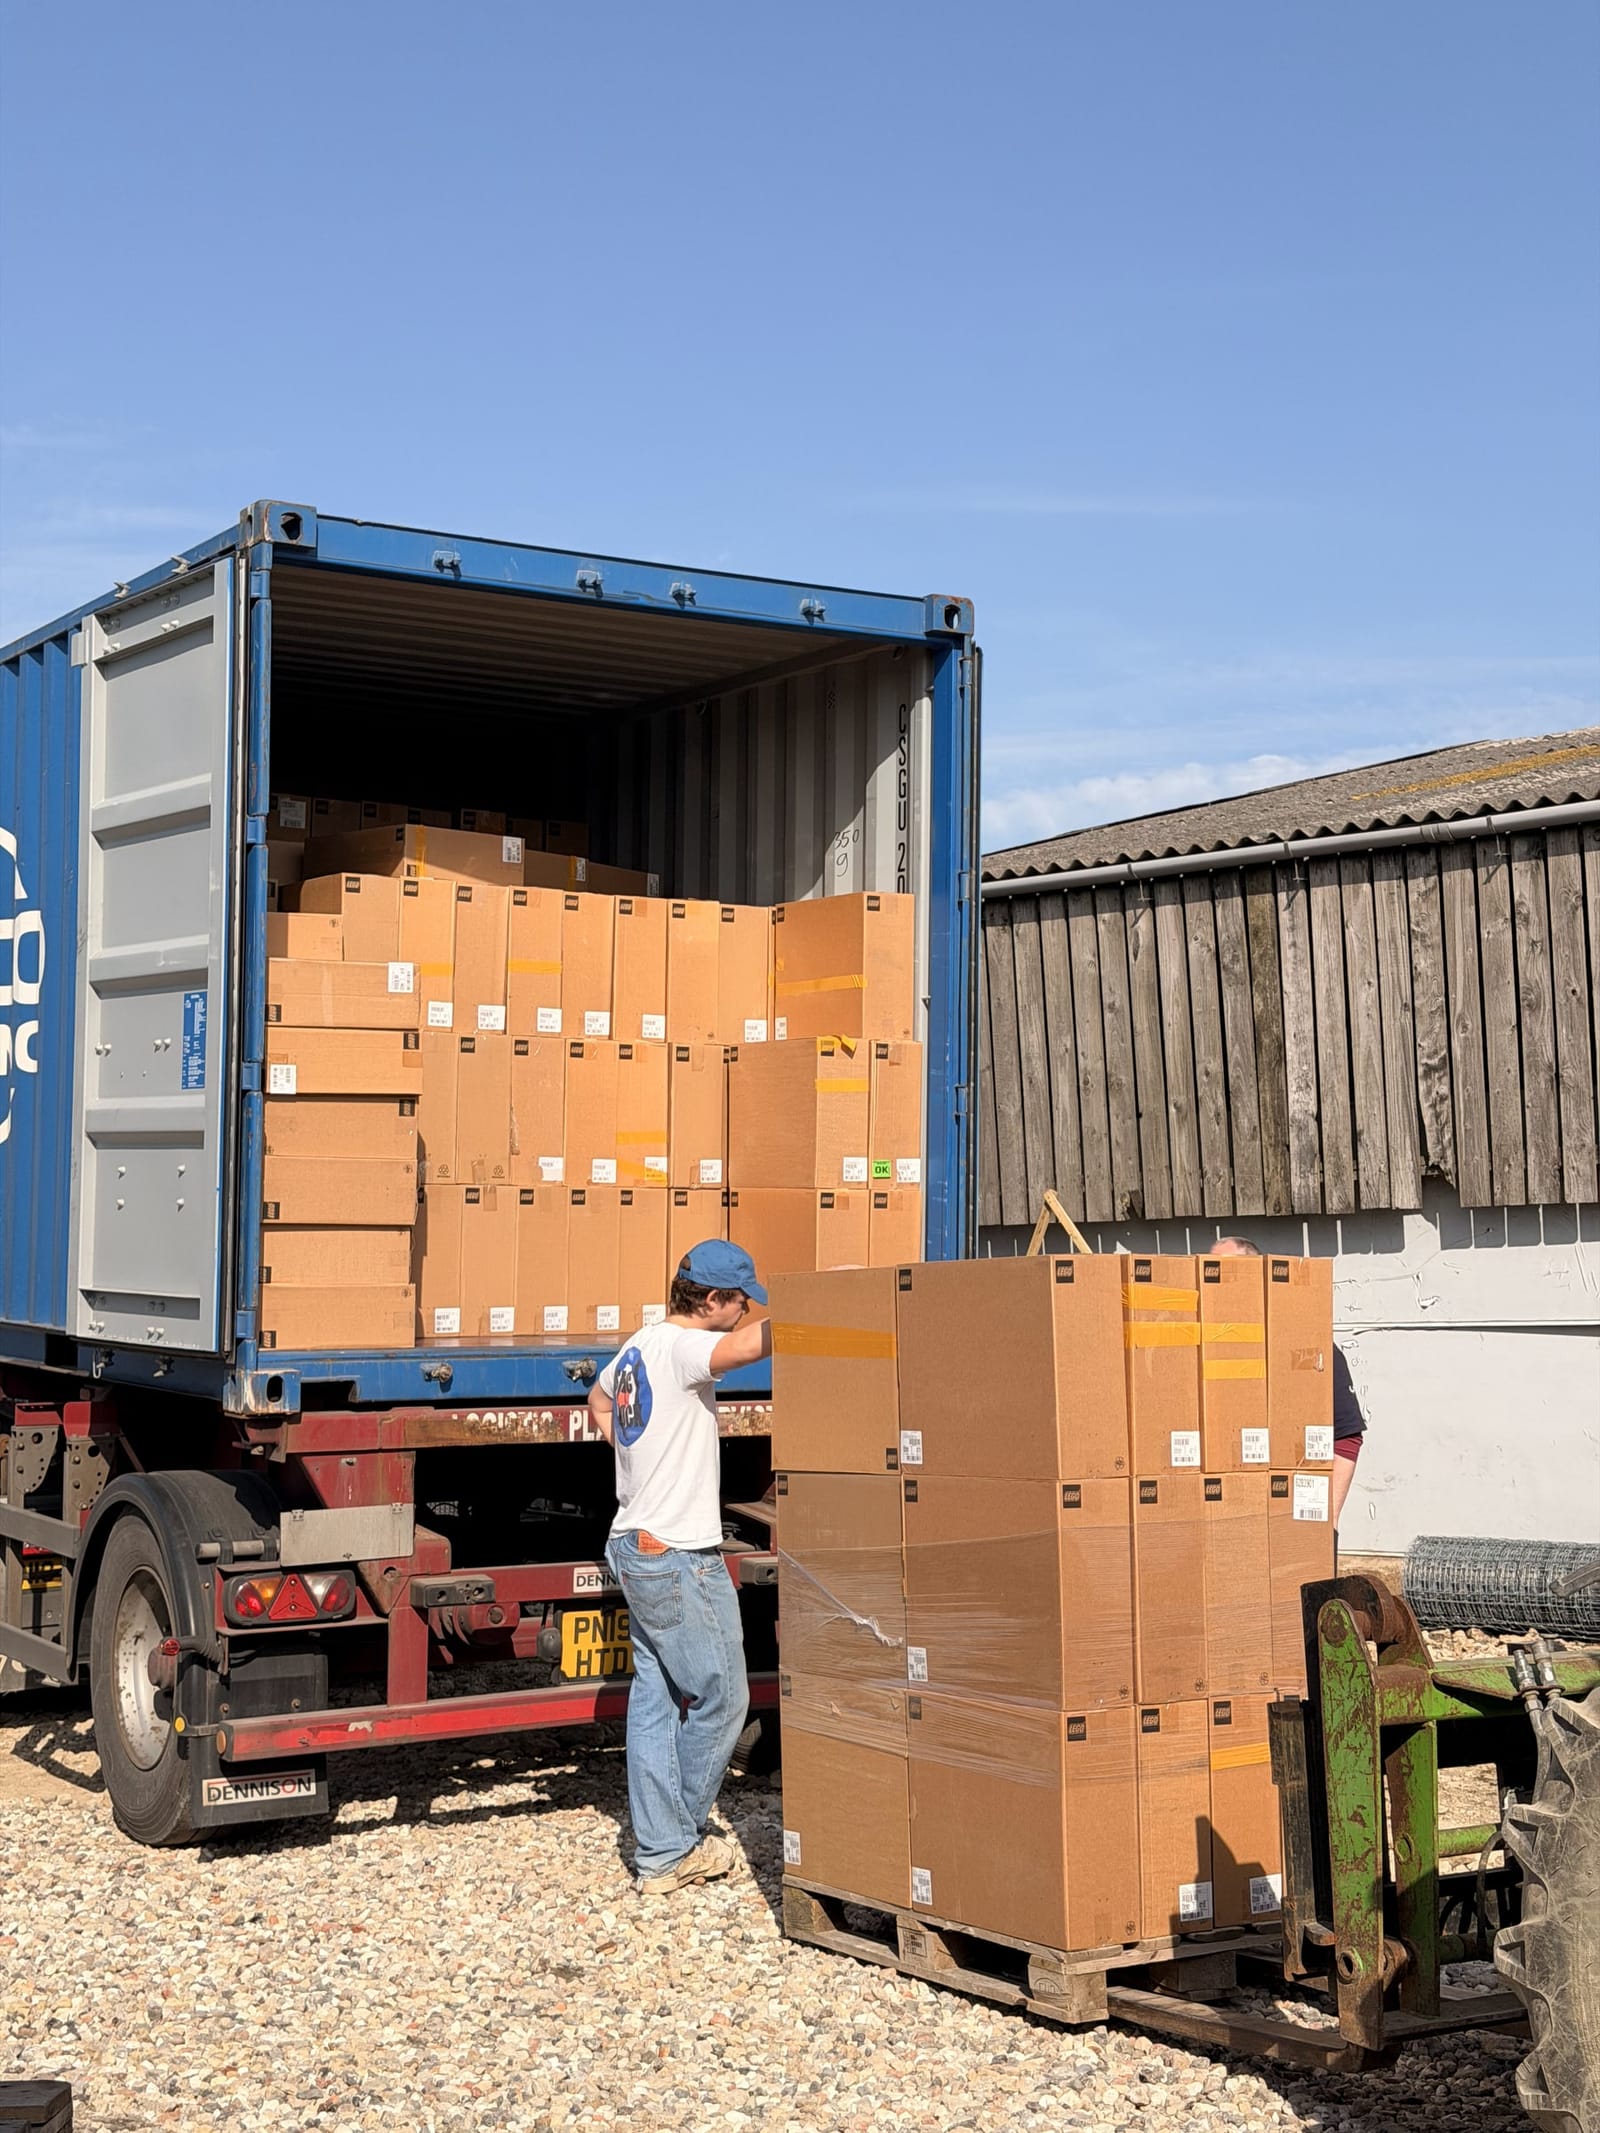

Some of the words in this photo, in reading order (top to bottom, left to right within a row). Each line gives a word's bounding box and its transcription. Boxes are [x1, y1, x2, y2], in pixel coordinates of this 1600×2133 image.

[898, 703, 908, 831] CSGU
[875, 1166, 888, 1174] OK
[1058, 1266, 1073, 1276] LEGO
[1137, 1266, 1150, 1276] LEGO
[1206, 1267, 1219, 1277] LEGO
[1274, 1266, 1288, 1276] LEGO
[569, 1409, 604, 1441] PL
[1206, 1484, 1221, 1494] LEGO
[1274, 1481, 1287, 1491] LEGO
[1065, 1491, 1080, 1501] LEGO
[1142, 1487, 1156, 1497] LEGO
[576, 1574, 620, 1587] DENN
[574, 1613, 631, 1645] PN19
[576, 1648, 628, 1678] HTD
[1216, 1708, 1230, 1718] LEGO
[1143, 1715, 1159, 1726] LEGO
[1069, 1723, 1085, 1733] LEGO
[207, 1777, 312, 1802] DENNISON
